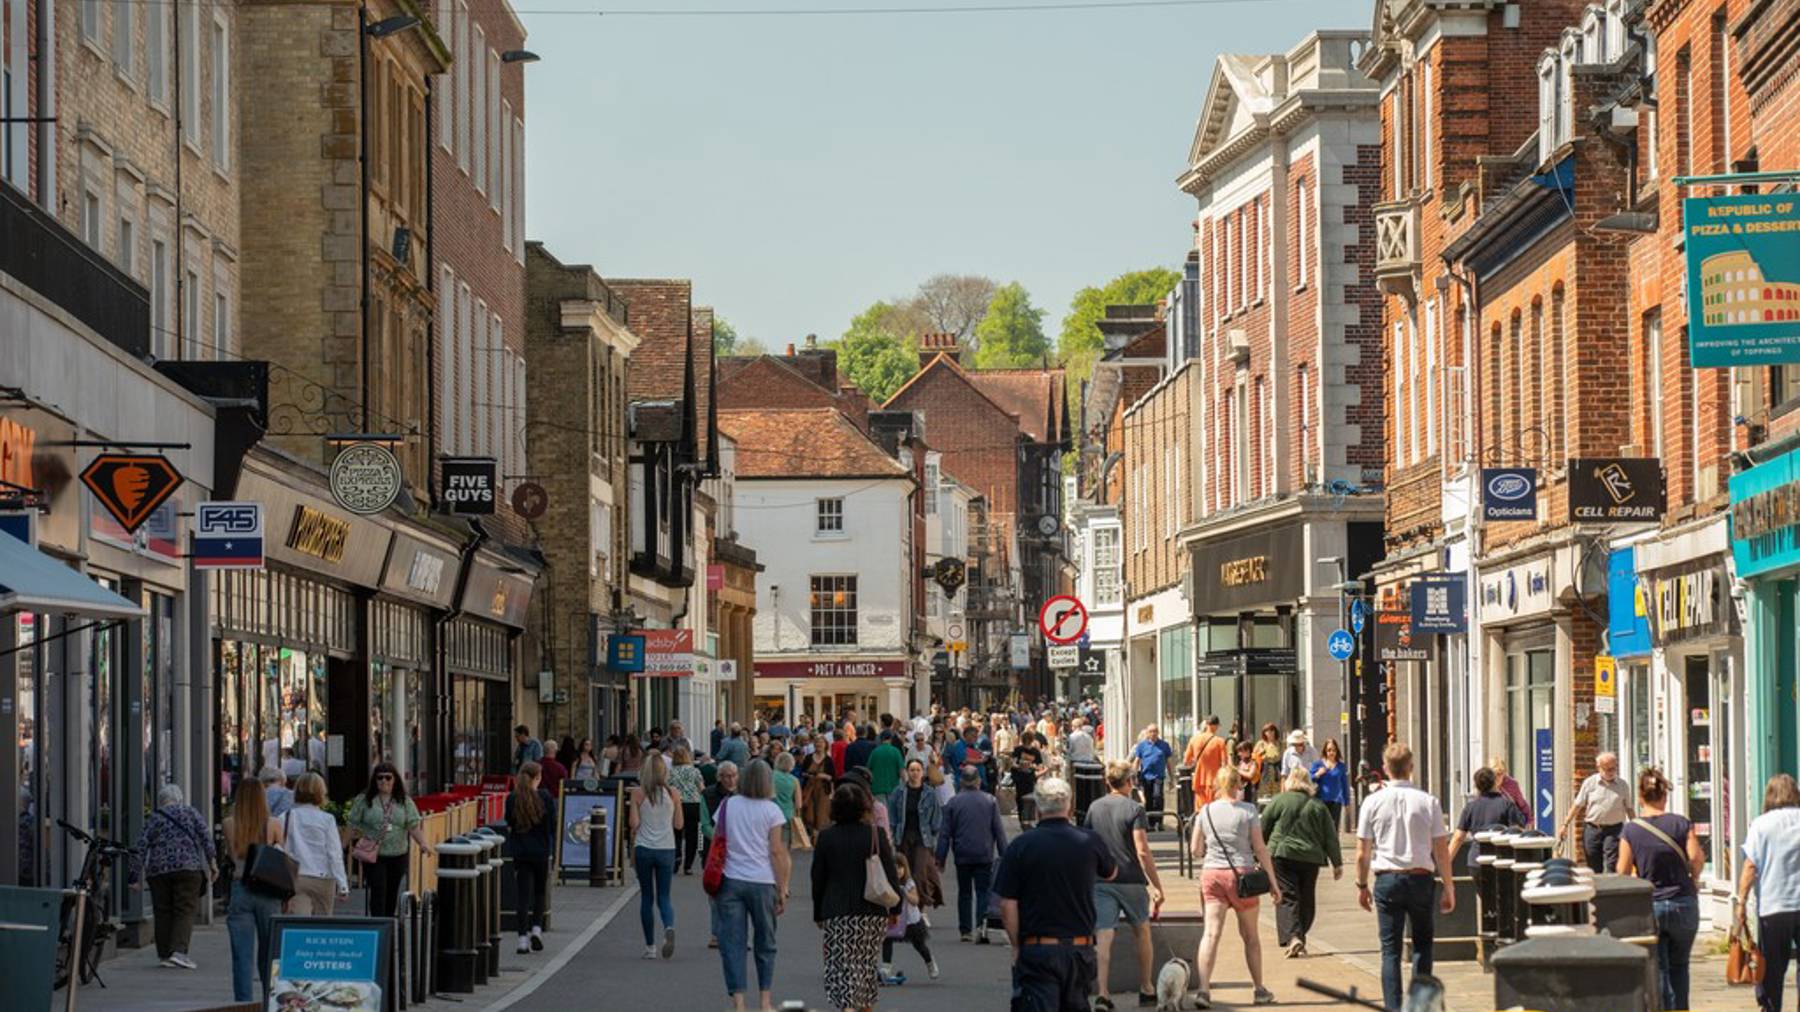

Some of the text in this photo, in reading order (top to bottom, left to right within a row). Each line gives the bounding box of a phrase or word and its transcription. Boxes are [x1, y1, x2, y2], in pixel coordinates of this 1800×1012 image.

[1708, 202, 1793, 217] REPUBLIC OF
[1691, 223, 1730, 236] PIZZA
[1732, 223, 1743, 234] &
[1695, 340, 1739, 348] IMPROVING
[1730, 347, 1782, 357] OF TOPPINGS
[349, 468, 382, 477] PIZZA
[340, 477, 391, 485] EXPRESS
[449, 475, 488, 488] FIVE
[444, 489, 493, 501] GUYS
[1488, 506, 1533, 517] Opticians
[1574, 506, 1656, 518] CELL REPAIR
[202, 506, 256, 531] F45
[1051, 648, 1076, 657] Except
[1381, 647, 1396, 659] the
[815, 663, 876, 676] PRET A MANGER
[306, 937, 354, 945] RICK STEIN
[303, 960, 352, 970] OYSTERS
